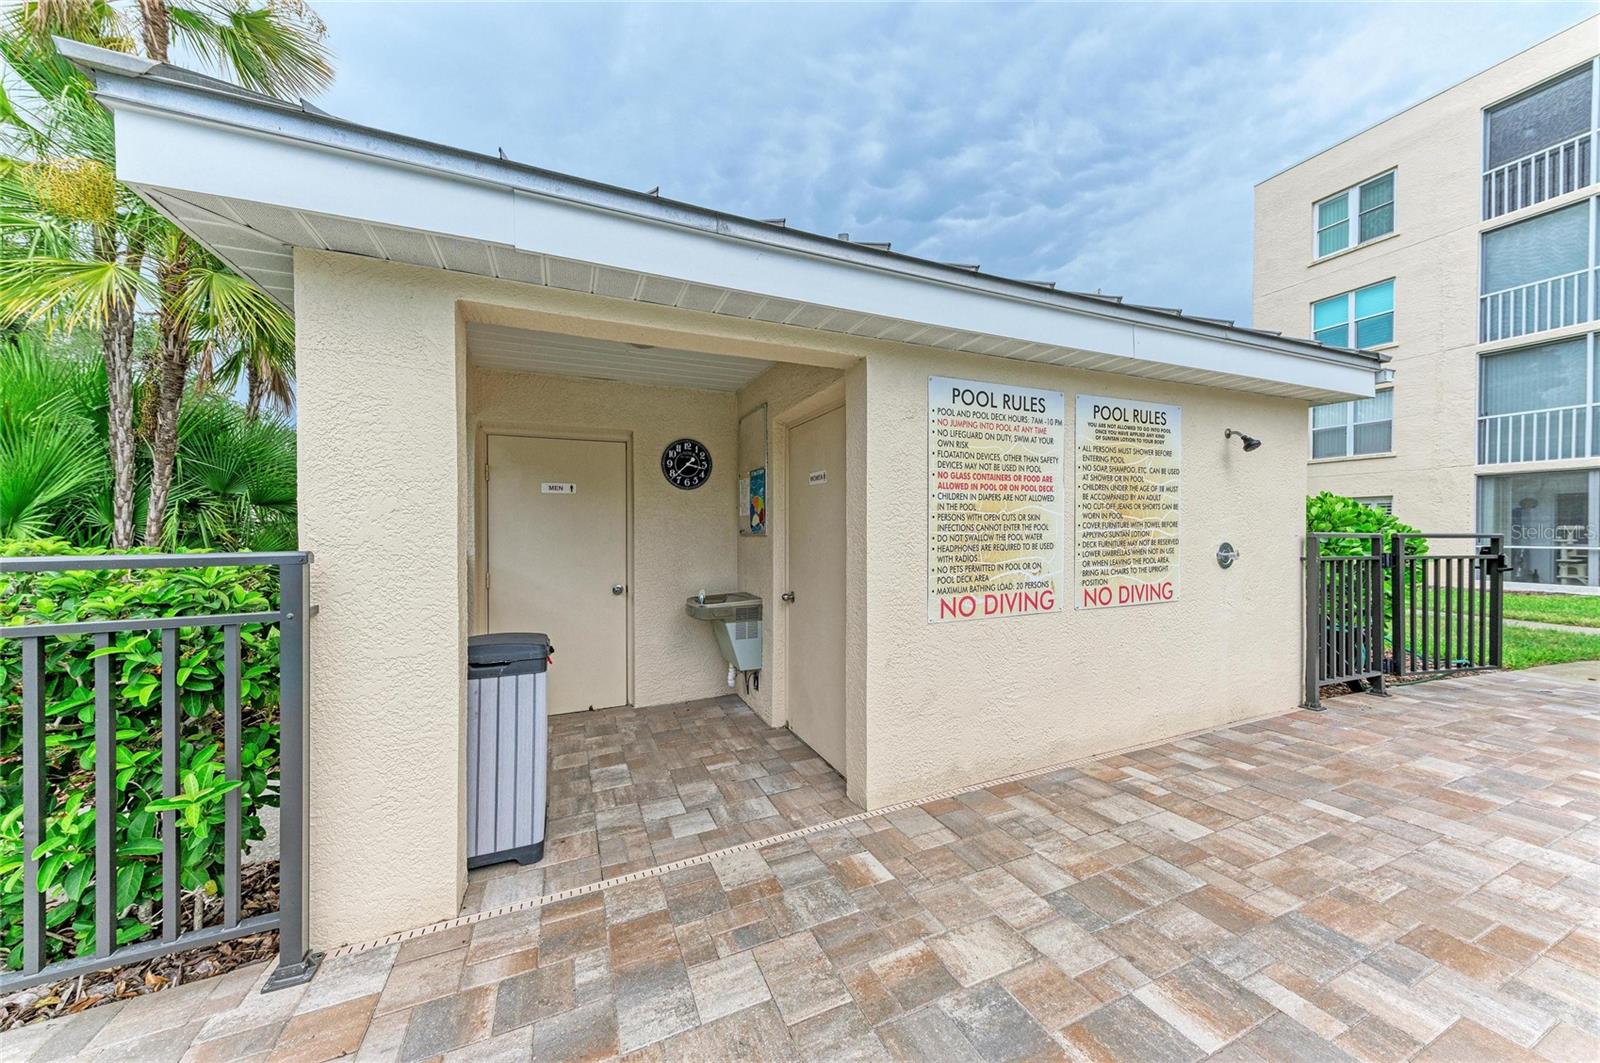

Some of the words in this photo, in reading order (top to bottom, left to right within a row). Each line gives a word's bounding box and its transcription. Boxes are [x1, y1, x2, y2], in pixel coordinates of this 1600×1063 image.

[952, 388, 997, 408] POOL
[1003, 393, 1046, 413] RULES
[938, 408, 955, 417] POOL
[957, 410, 970, 418] AND
[973, 411, 989, 420] POOL
[991, 413, 1006, 421] DECK
[1094, 405, 1129, 422] POOL
[1133, 409, 1167, 425] RULES
[950, 420, 978, 428] JUMPING
[950, 431, 983, 440] LIFEGUARD
[938, 451, 975, 459] FLOATATION
[938, 461, 962, 469] DEVICES
[973, 473, 1011, 481] CONTAINERS
[938, 482, 968, 490] ALLOWED
[965, 564, 995, 572] PERMITTED
[1082, 578, 1108, 586] POSITION
[937, 586, 968, 595] MAXIMUM
[970, 584, 996, 593] BATHING
[1084, 586, 1112, 607] NO
[1119, 582, 1173, 604] DIVING
[940, 595, 976, 619] NO
[985, 590, 1054, 615] DIVING
